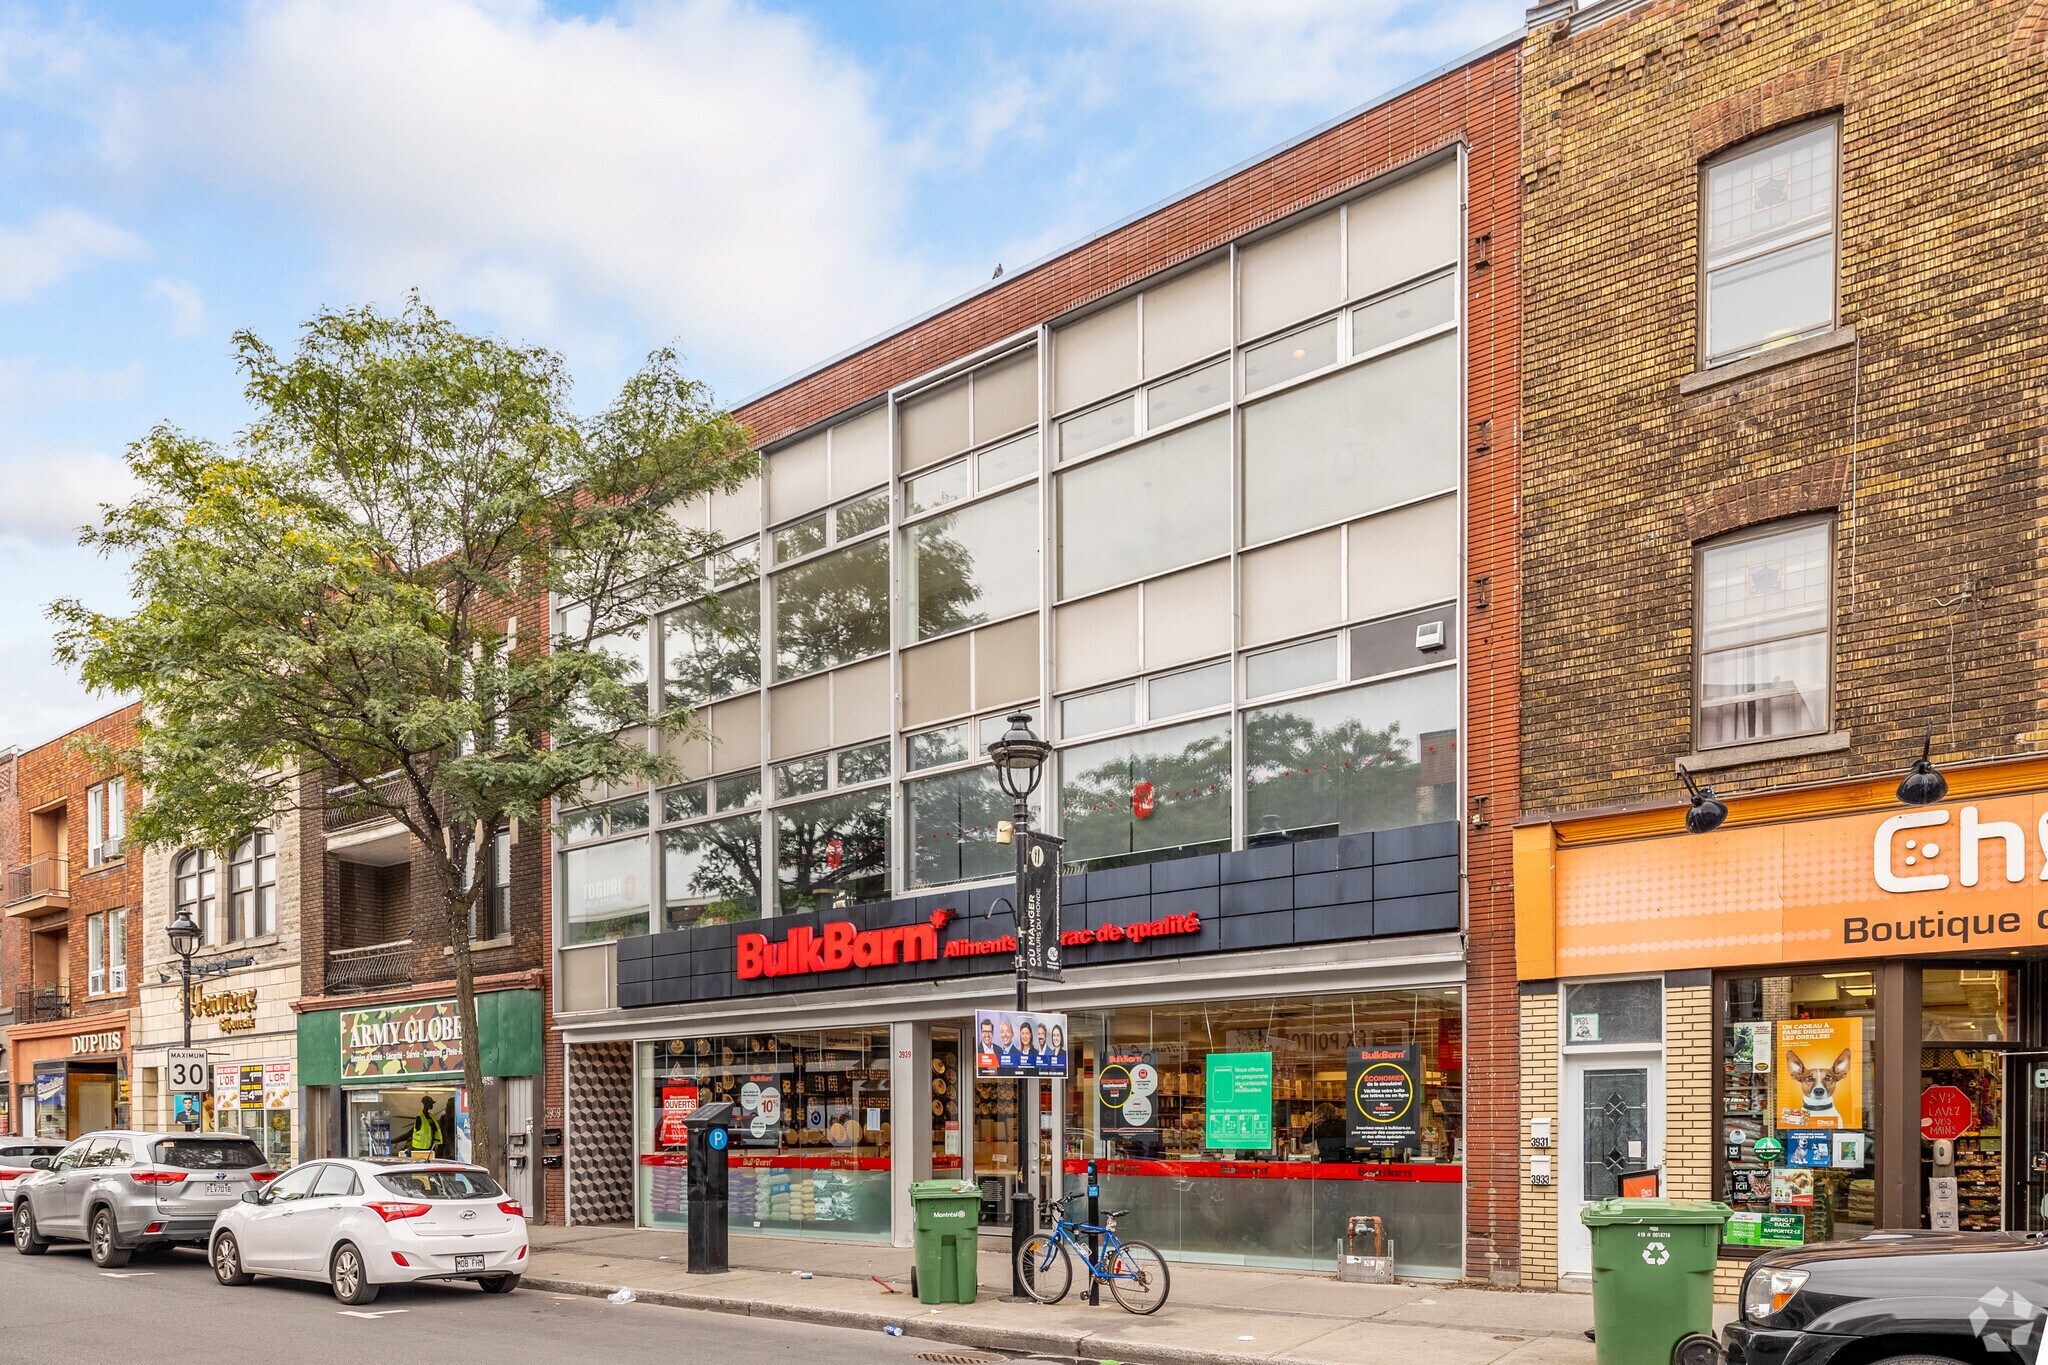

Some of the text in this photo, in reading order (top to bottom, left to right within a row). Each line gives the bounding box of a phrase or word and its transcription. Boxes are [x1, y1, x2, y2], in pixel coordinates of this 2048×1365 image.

[582, 878, 622, 900] TOGURI
[600, 896, 622, 906] STUDIO
[1035, 918, 1042, 929] DU
[1844, 910, 2021, 945] Boutique
[944, 910, 1201, 958] Aliments rac de qualité
[1028, 894, 1037, 967] OÙ MANGER
[737, 921, 938, 980] BulkBarn
[1573, 1017, 1589, 1025] 3931
[350, 1016, 463, 1048] ARMY GLOBE
[71, 1031, 122, 1054] DUPUIS
[423, 1048, 441, 1058] Camping
[1361, 1050, 1405, 1060] BulkBarn
[173, 1064, 204, 1085] 30
[269, 1074, 286, 1082] L'OR
[1364, 1074, 1405, 1082] ÉCONOMIES
[219, 1076, 235, 1086] L'OR
[665, 1100, 696, 1109] OUVERTS
[761, 1099, 779, 1113] 10%
[1928, 1106, 1960, 1117] LAVEZ
[1934, 1118, 1952, 1126] VOS
[1930, 1125, 1957, 1135] MAINS
[1531, 1137, 1549, 1147] 3931
[1531, 1175, 1550, 1185] 3933
[933, 1211, 959, 1219] Montréal
